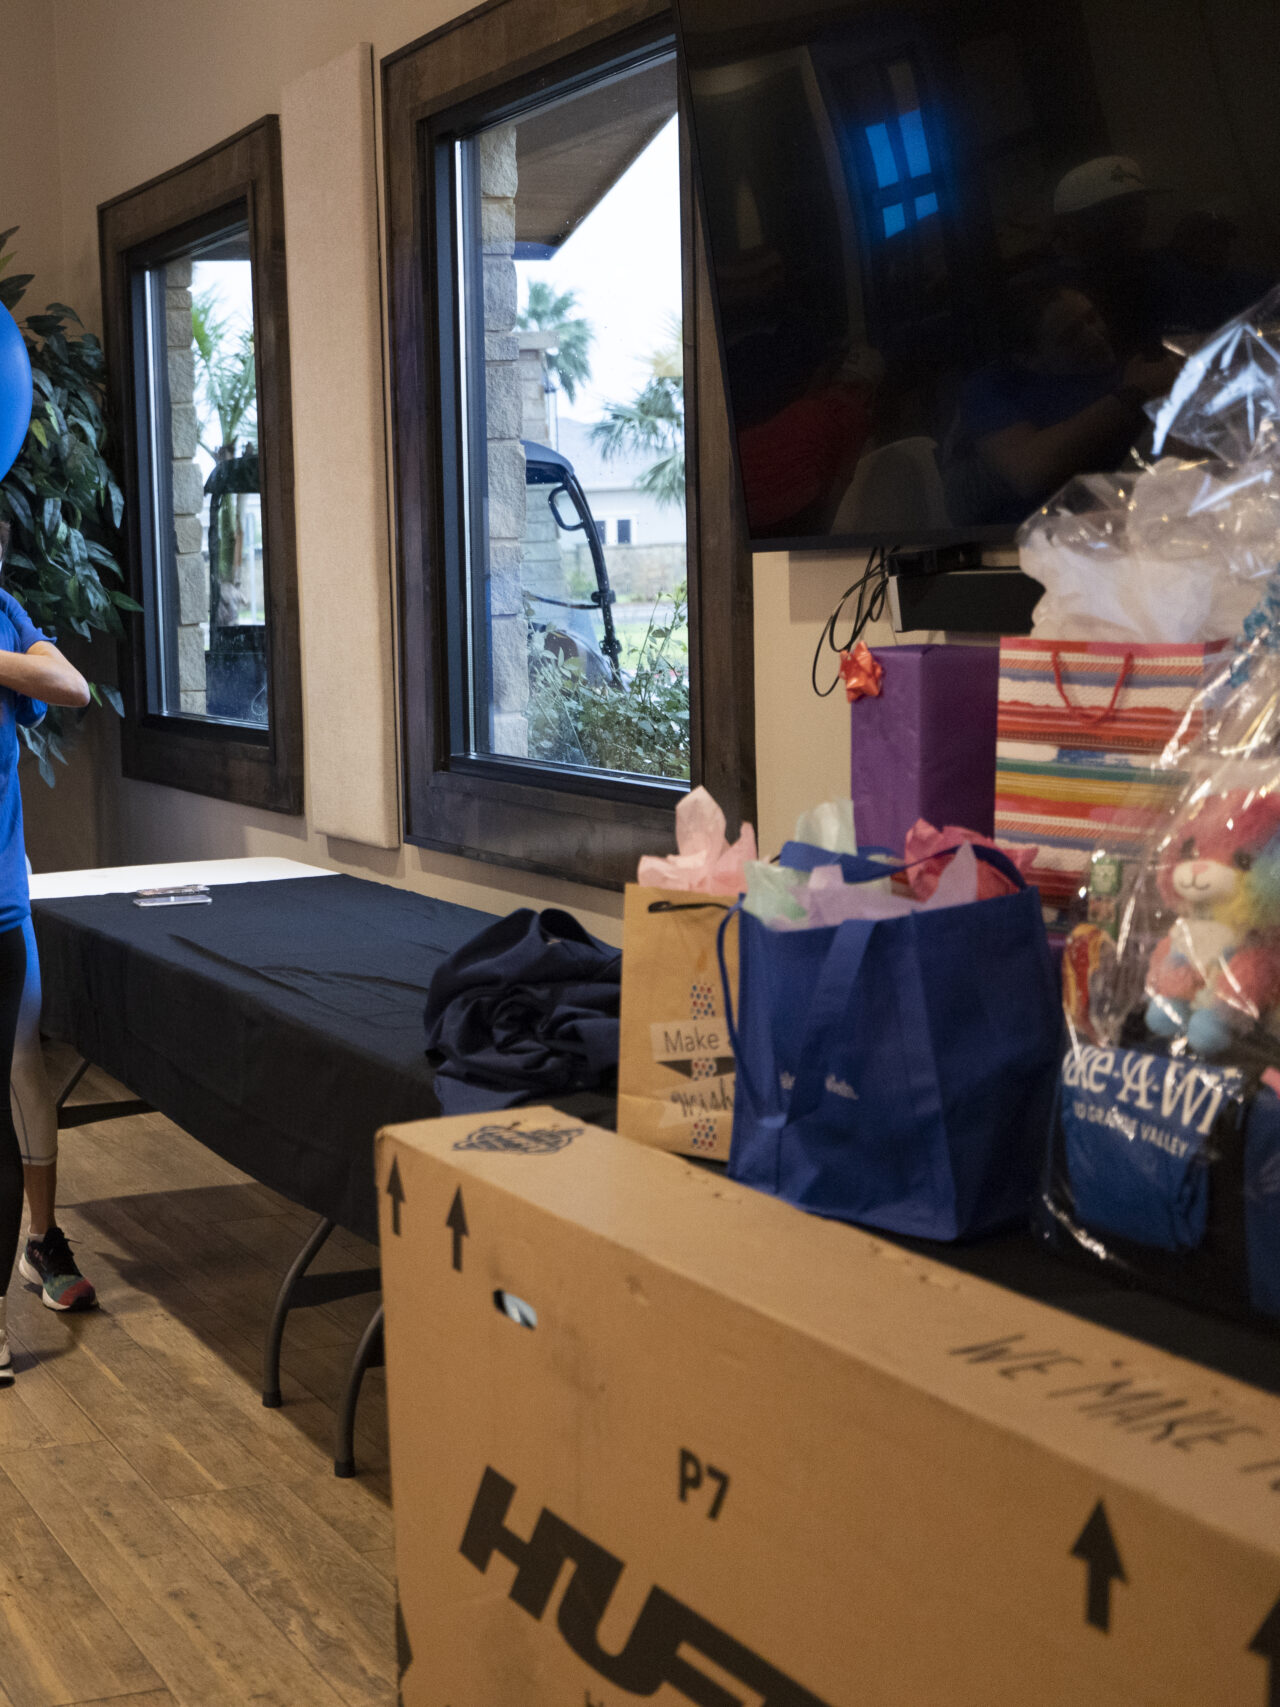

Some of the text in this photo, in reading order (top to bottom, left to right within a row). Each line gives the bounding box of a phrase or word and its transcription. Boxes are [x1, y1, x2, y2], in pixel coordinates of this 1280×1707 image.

[663, 1026, 720, 1054] Make
[1141, 1122, 1190, 1159] VALLEY
[948, 1333, 1264, 1453] WE MAKE
[677, 1447, 732, 1522] P7
